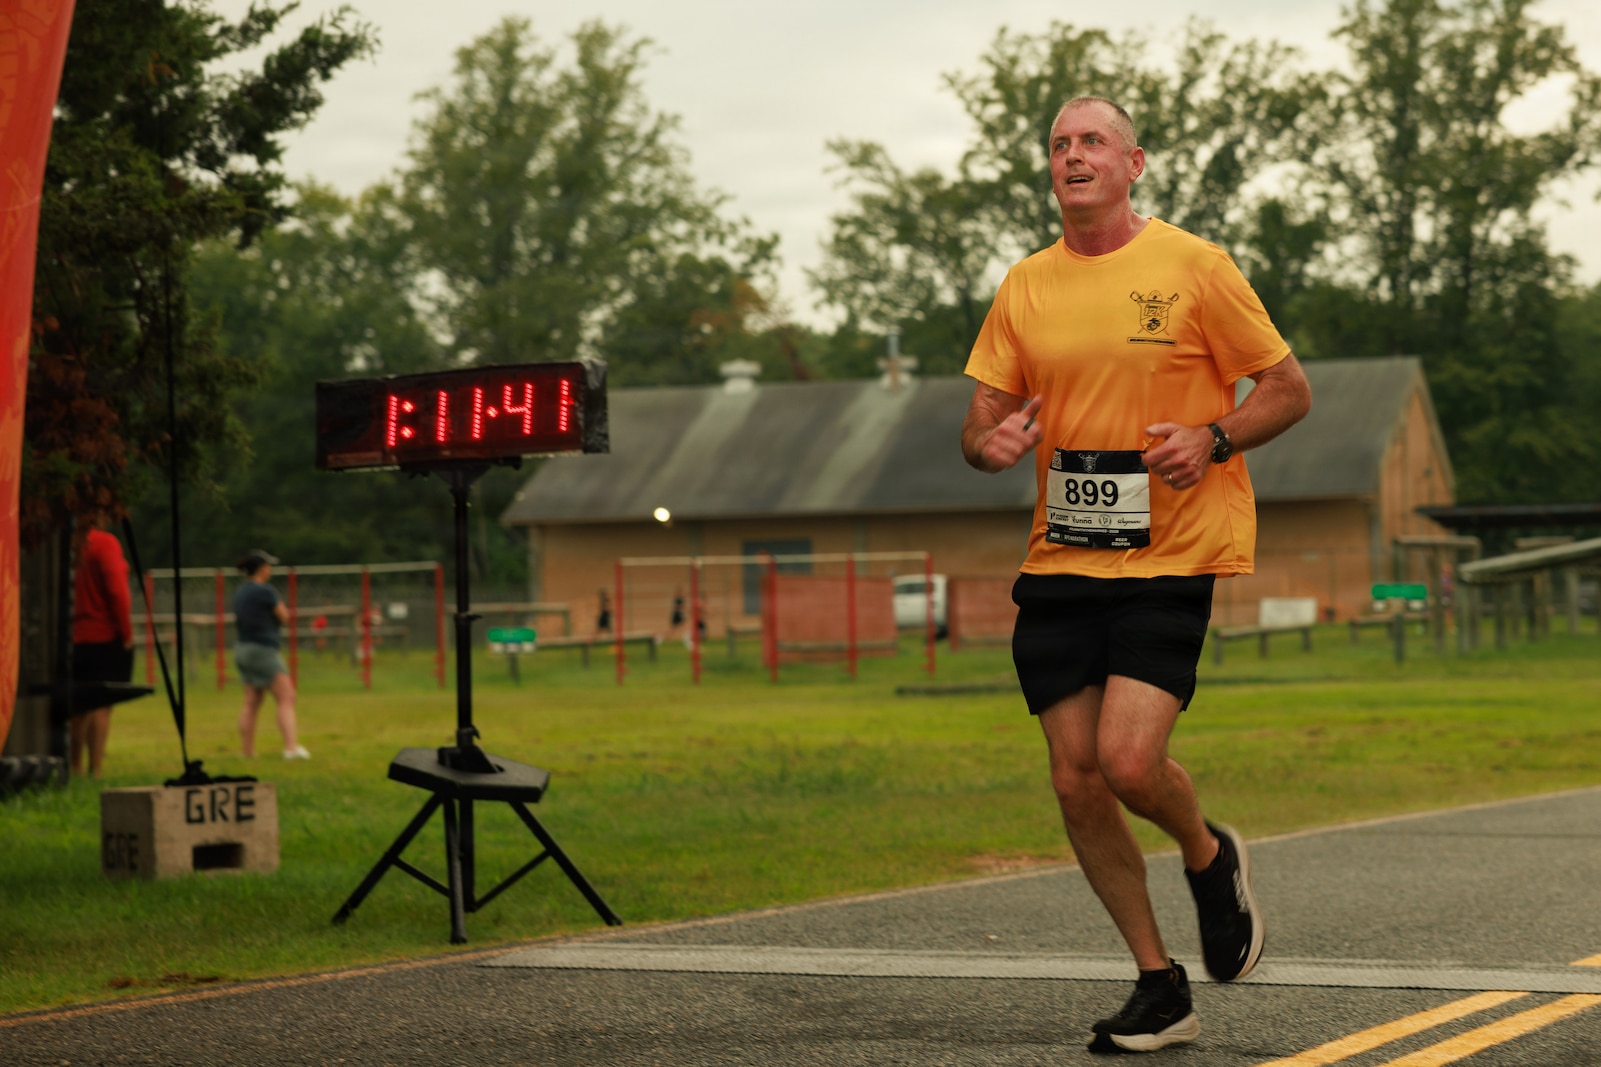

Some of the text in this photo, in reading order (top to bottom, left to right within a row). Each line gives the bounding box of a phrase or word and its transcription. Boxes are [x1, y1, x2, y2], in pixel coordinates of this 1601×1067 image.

[1065, 478, 1119, 507] 899
[185, 786, 256, 824] GRE
[103, 831, 139, 871] GRE
